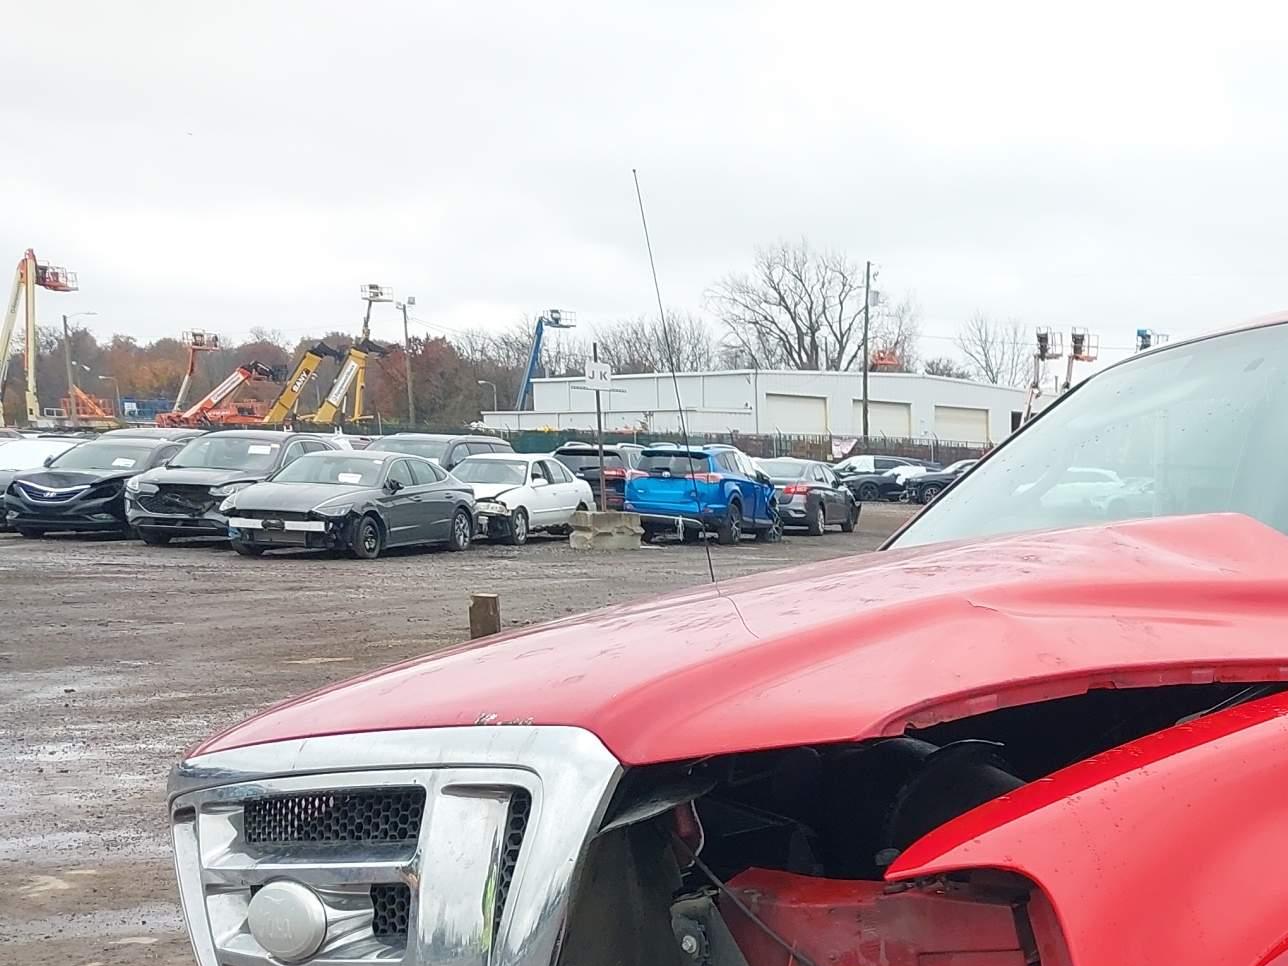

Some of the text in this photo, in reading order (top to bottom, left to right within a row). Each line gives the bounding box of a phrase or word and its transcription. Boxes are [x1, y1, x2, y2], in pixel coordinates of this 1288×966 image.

[292, 371, 308, 393] SANY
[588, 370, 608, 381] J K
